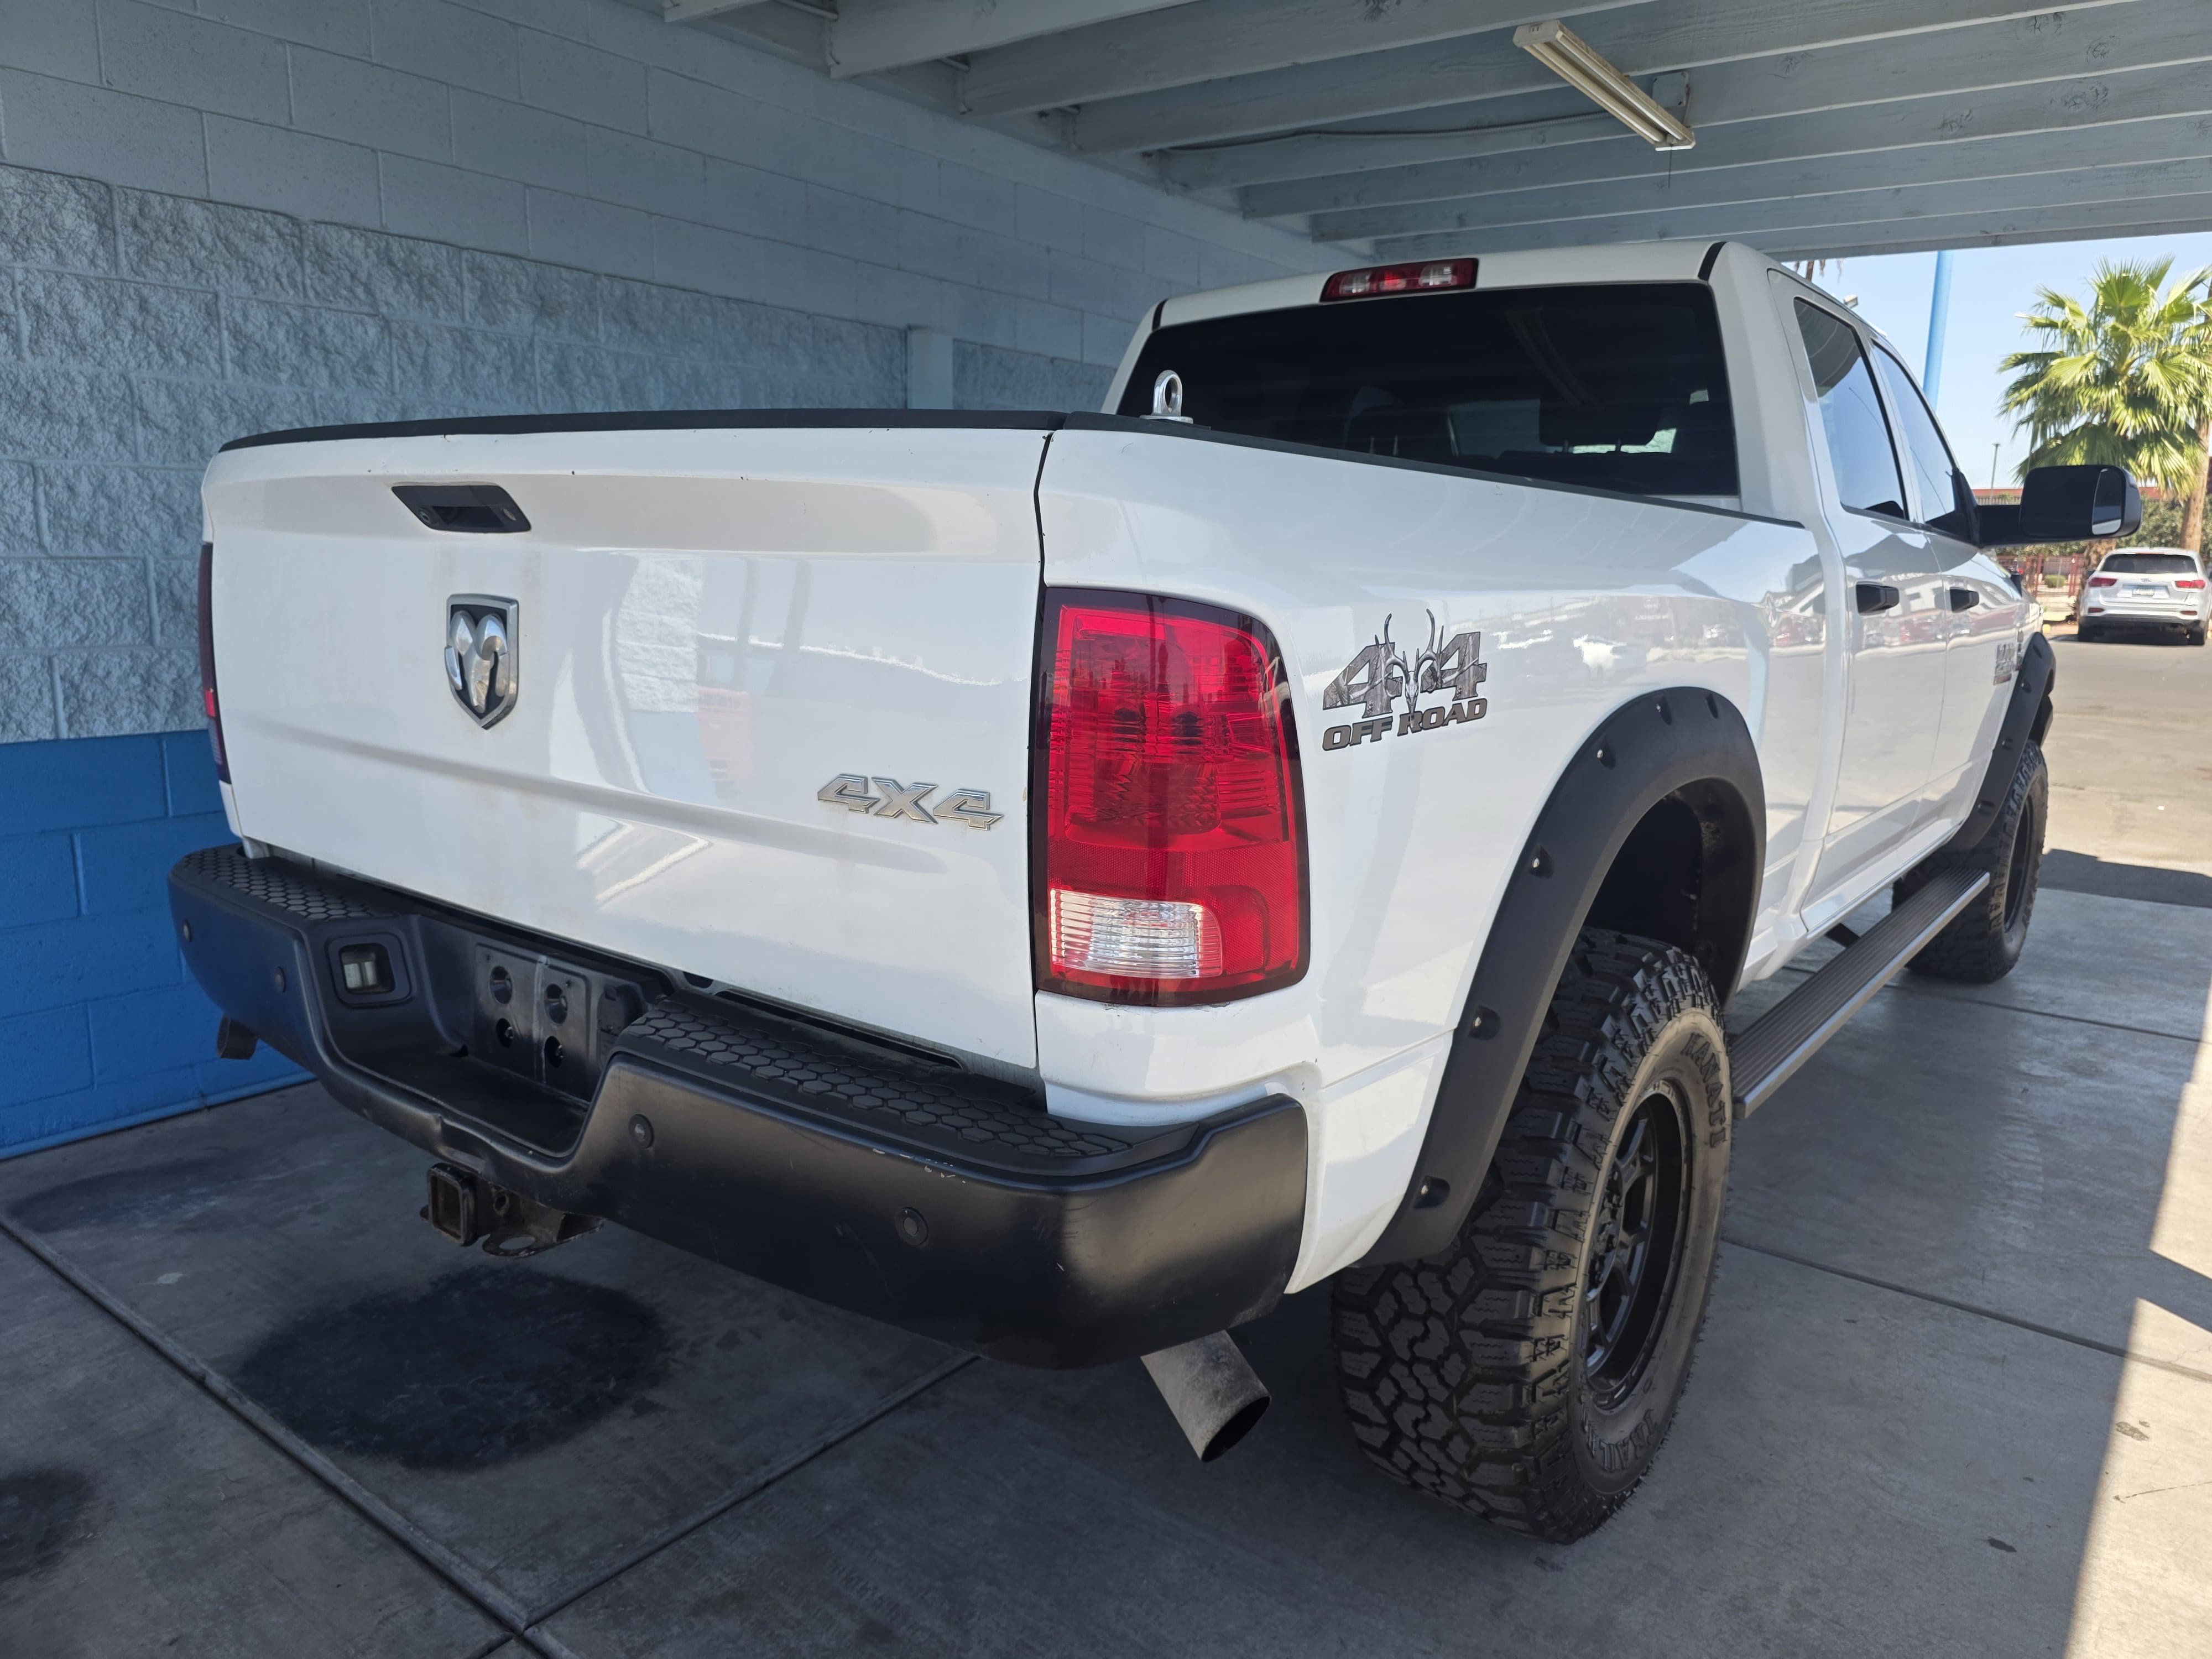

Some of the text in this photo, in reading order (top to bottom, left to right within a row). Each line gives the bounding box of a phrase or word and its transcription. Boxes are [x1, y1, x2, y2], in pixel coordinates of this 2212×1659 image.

[1322, 698, 1488, 751] OFF ROAD
[817, 773, 1005, 831] 4X4
